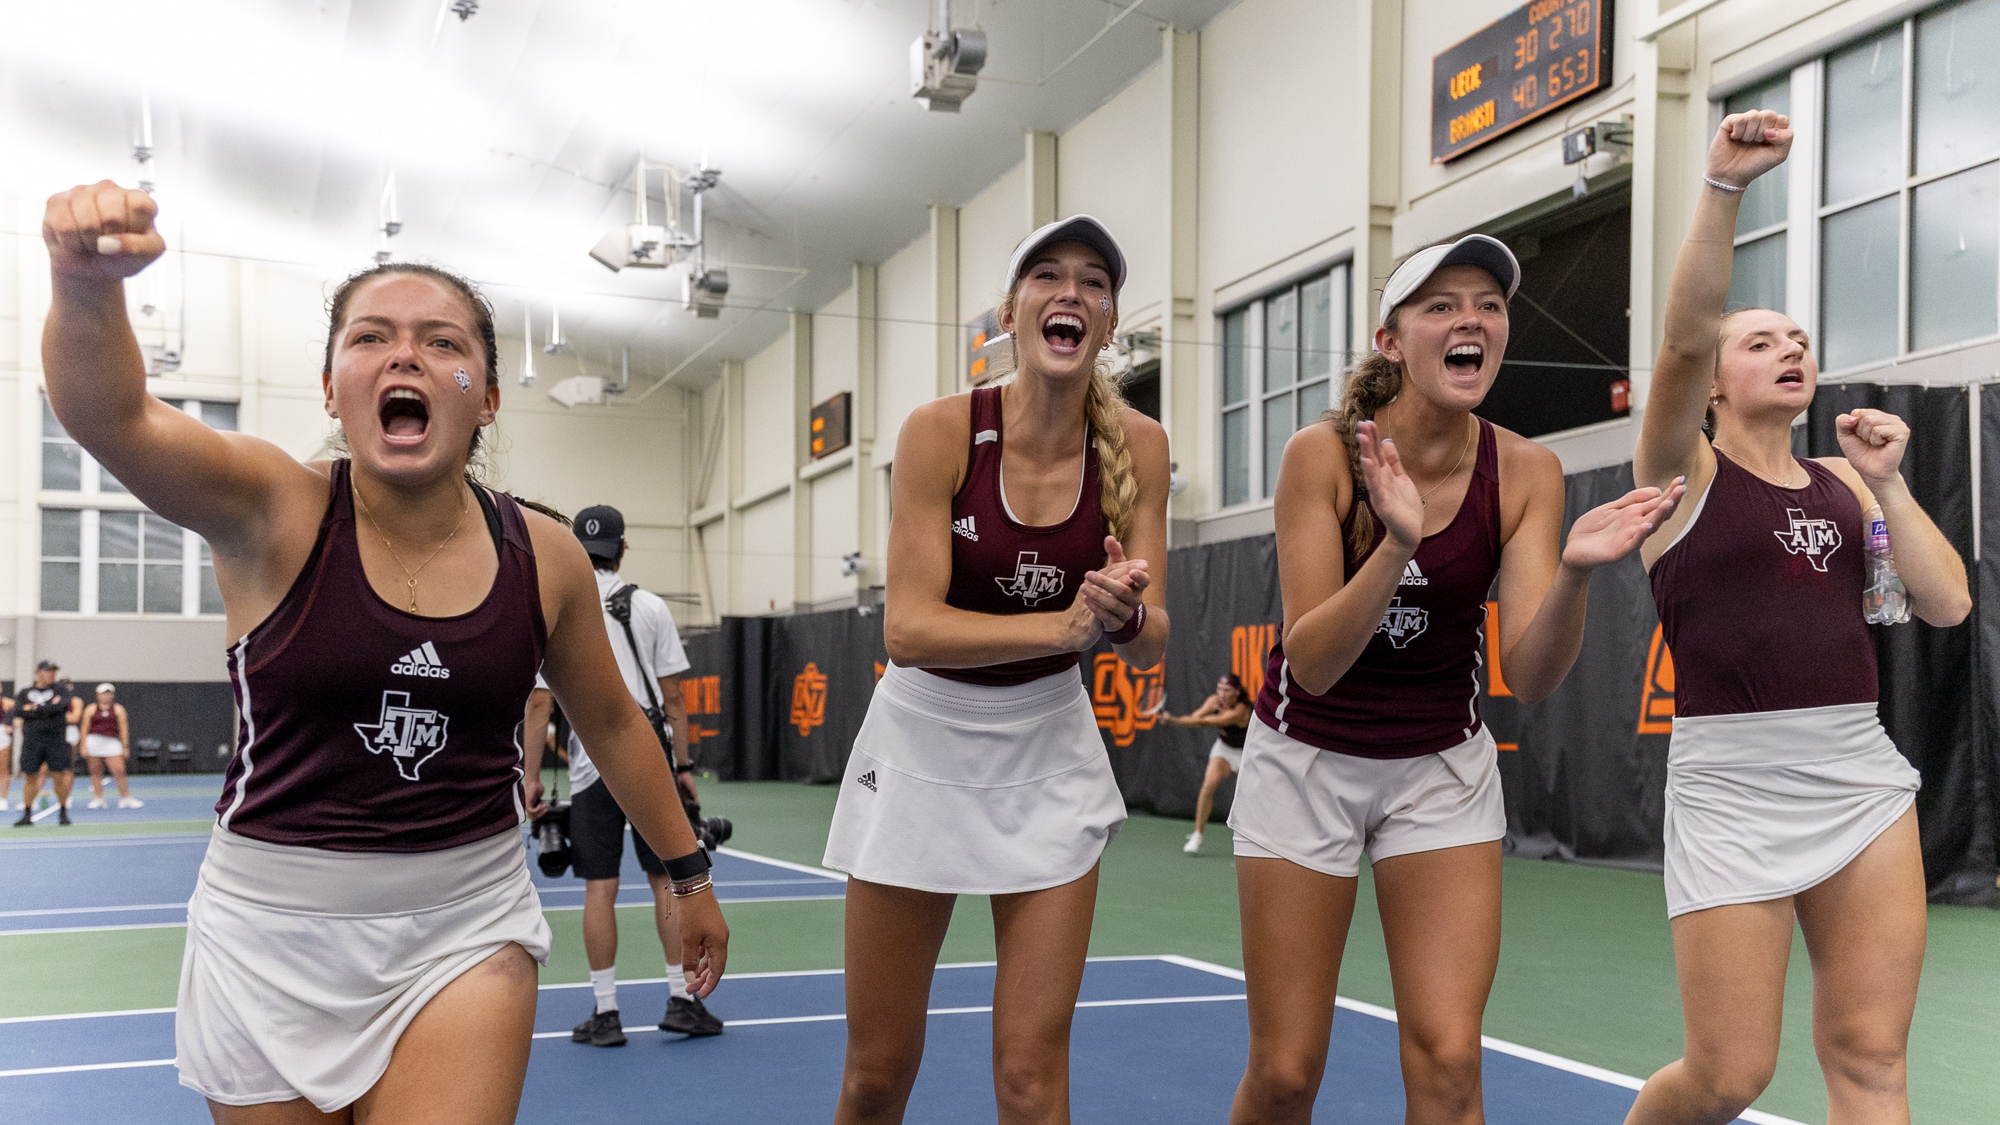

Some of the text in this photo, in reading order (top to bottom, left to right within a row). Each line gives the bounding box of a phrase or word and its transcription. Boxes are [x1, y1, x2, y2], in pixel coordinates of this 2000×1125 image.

[1514, 28, 1538, 70] 30
[1513, 75, 1538, 110] 40
[390, 662, 451, 679] adidas
